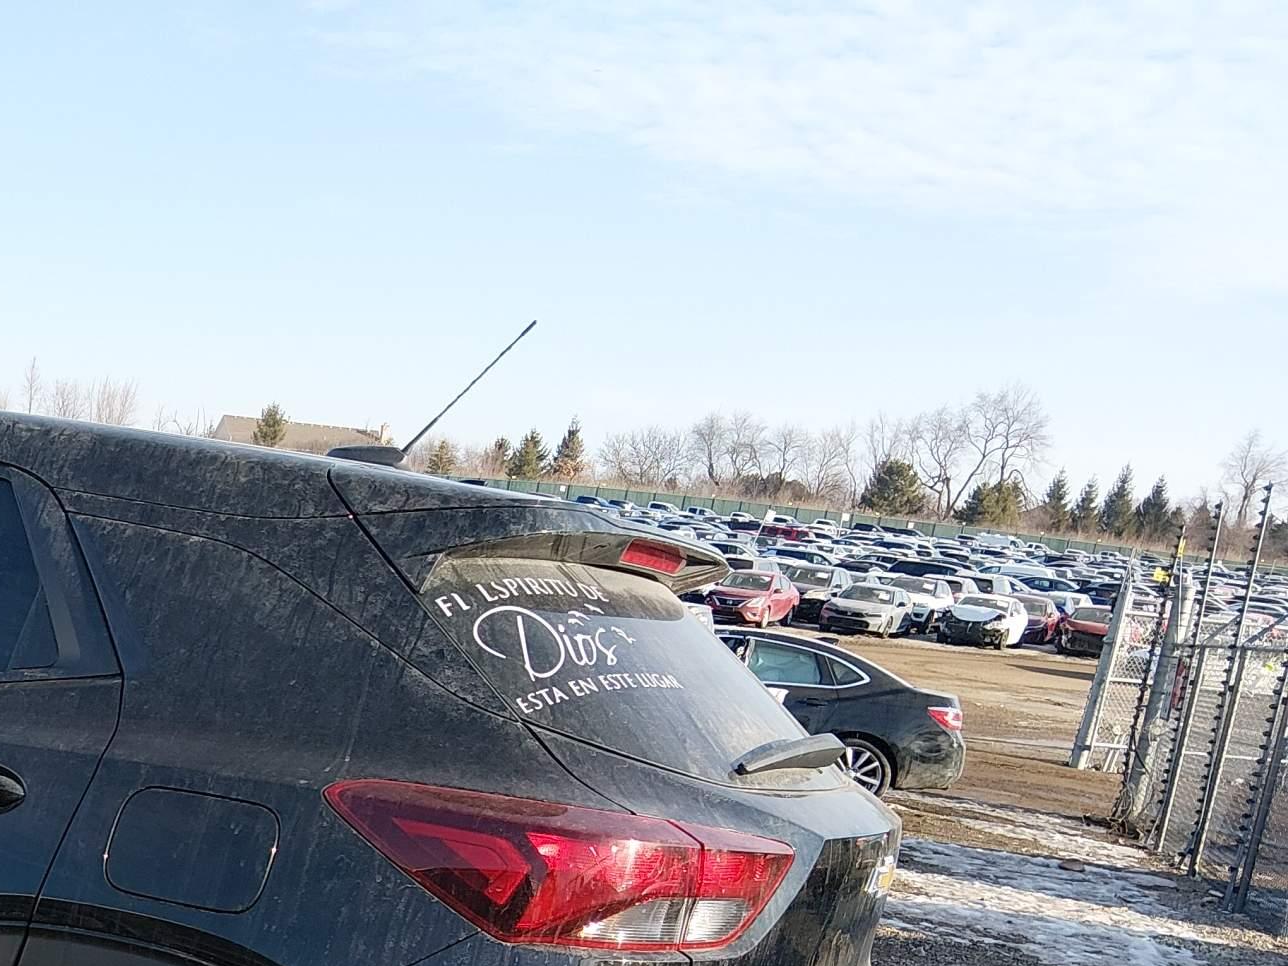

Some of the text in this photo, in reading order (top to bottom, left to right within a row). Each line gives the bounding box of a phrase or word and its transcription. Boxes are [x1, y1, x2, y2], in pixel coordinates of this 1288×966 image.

[472, 605, 618, 682] Dios
[516, 672, 684, 714] ESTA EN ESTE LUGAR
